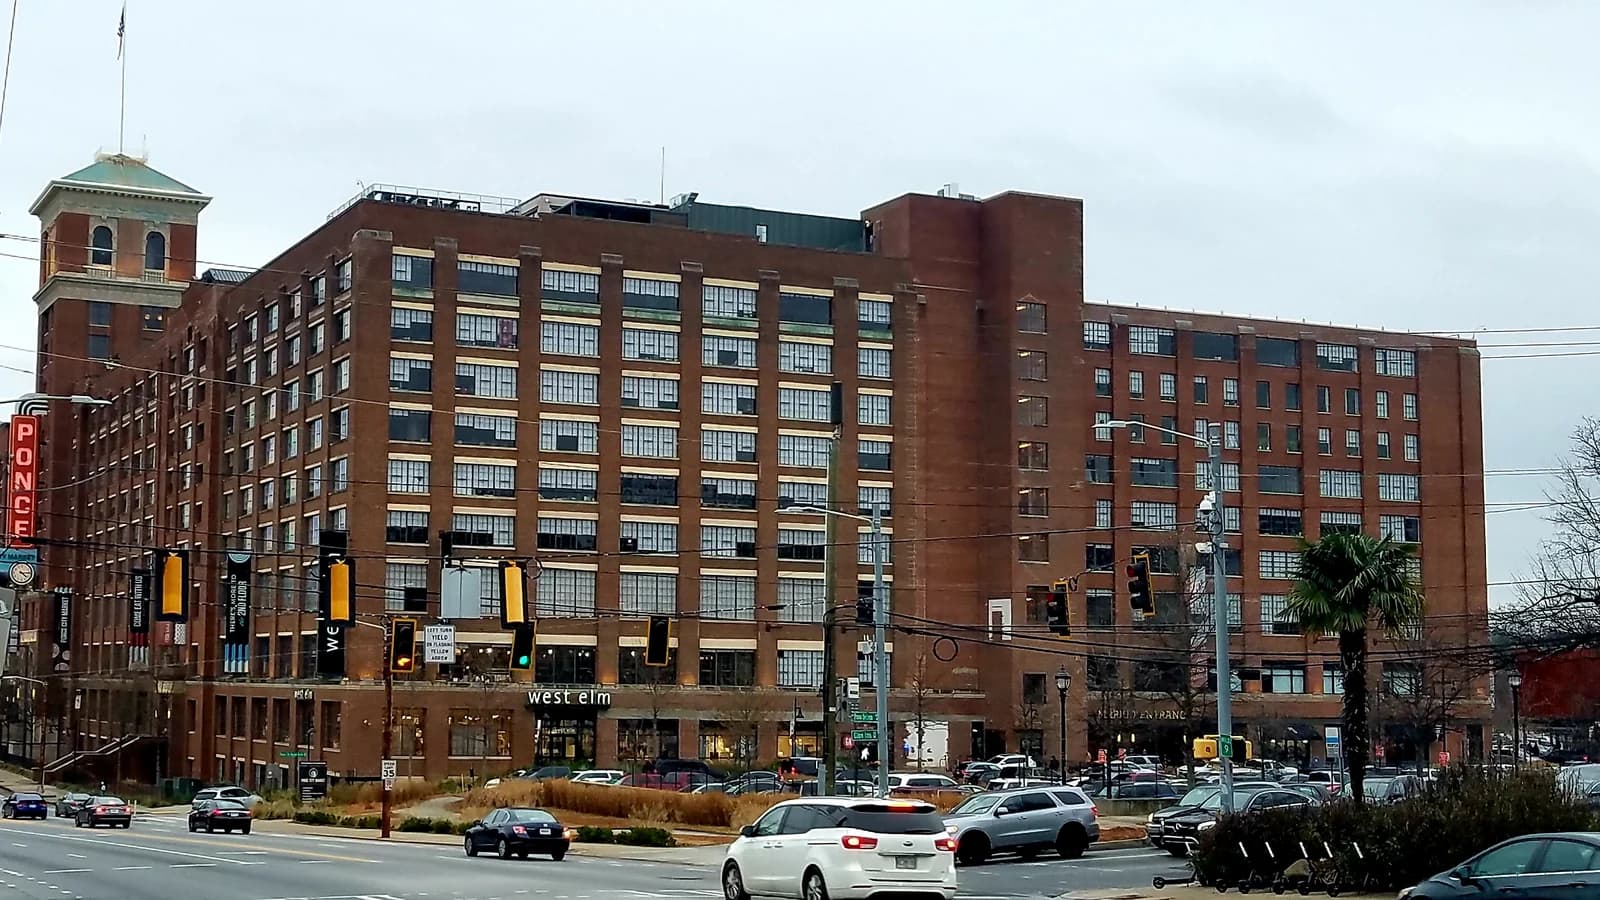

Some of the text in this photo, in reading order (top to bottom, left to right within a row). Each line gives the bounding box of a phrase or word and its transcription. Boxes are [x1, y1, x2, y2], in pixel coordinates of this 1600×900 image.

[14, 423, 33, 537] PONCE
[134, 575, 143, 584] US
[230, 574, 237, 583] TO
[238, 580, 248, 601] FLOOR
[133, 600, 142, 610] EAT
[237, 602, 247, 616] 2ND
[133, 611, 142, 627] COME
[528, 689, 611, 704] west elm
[1139, 709, 1186, 720] ENTRANC
[1224, 744, 1229, 753] 9
[383, 769, 395, 778] 35
